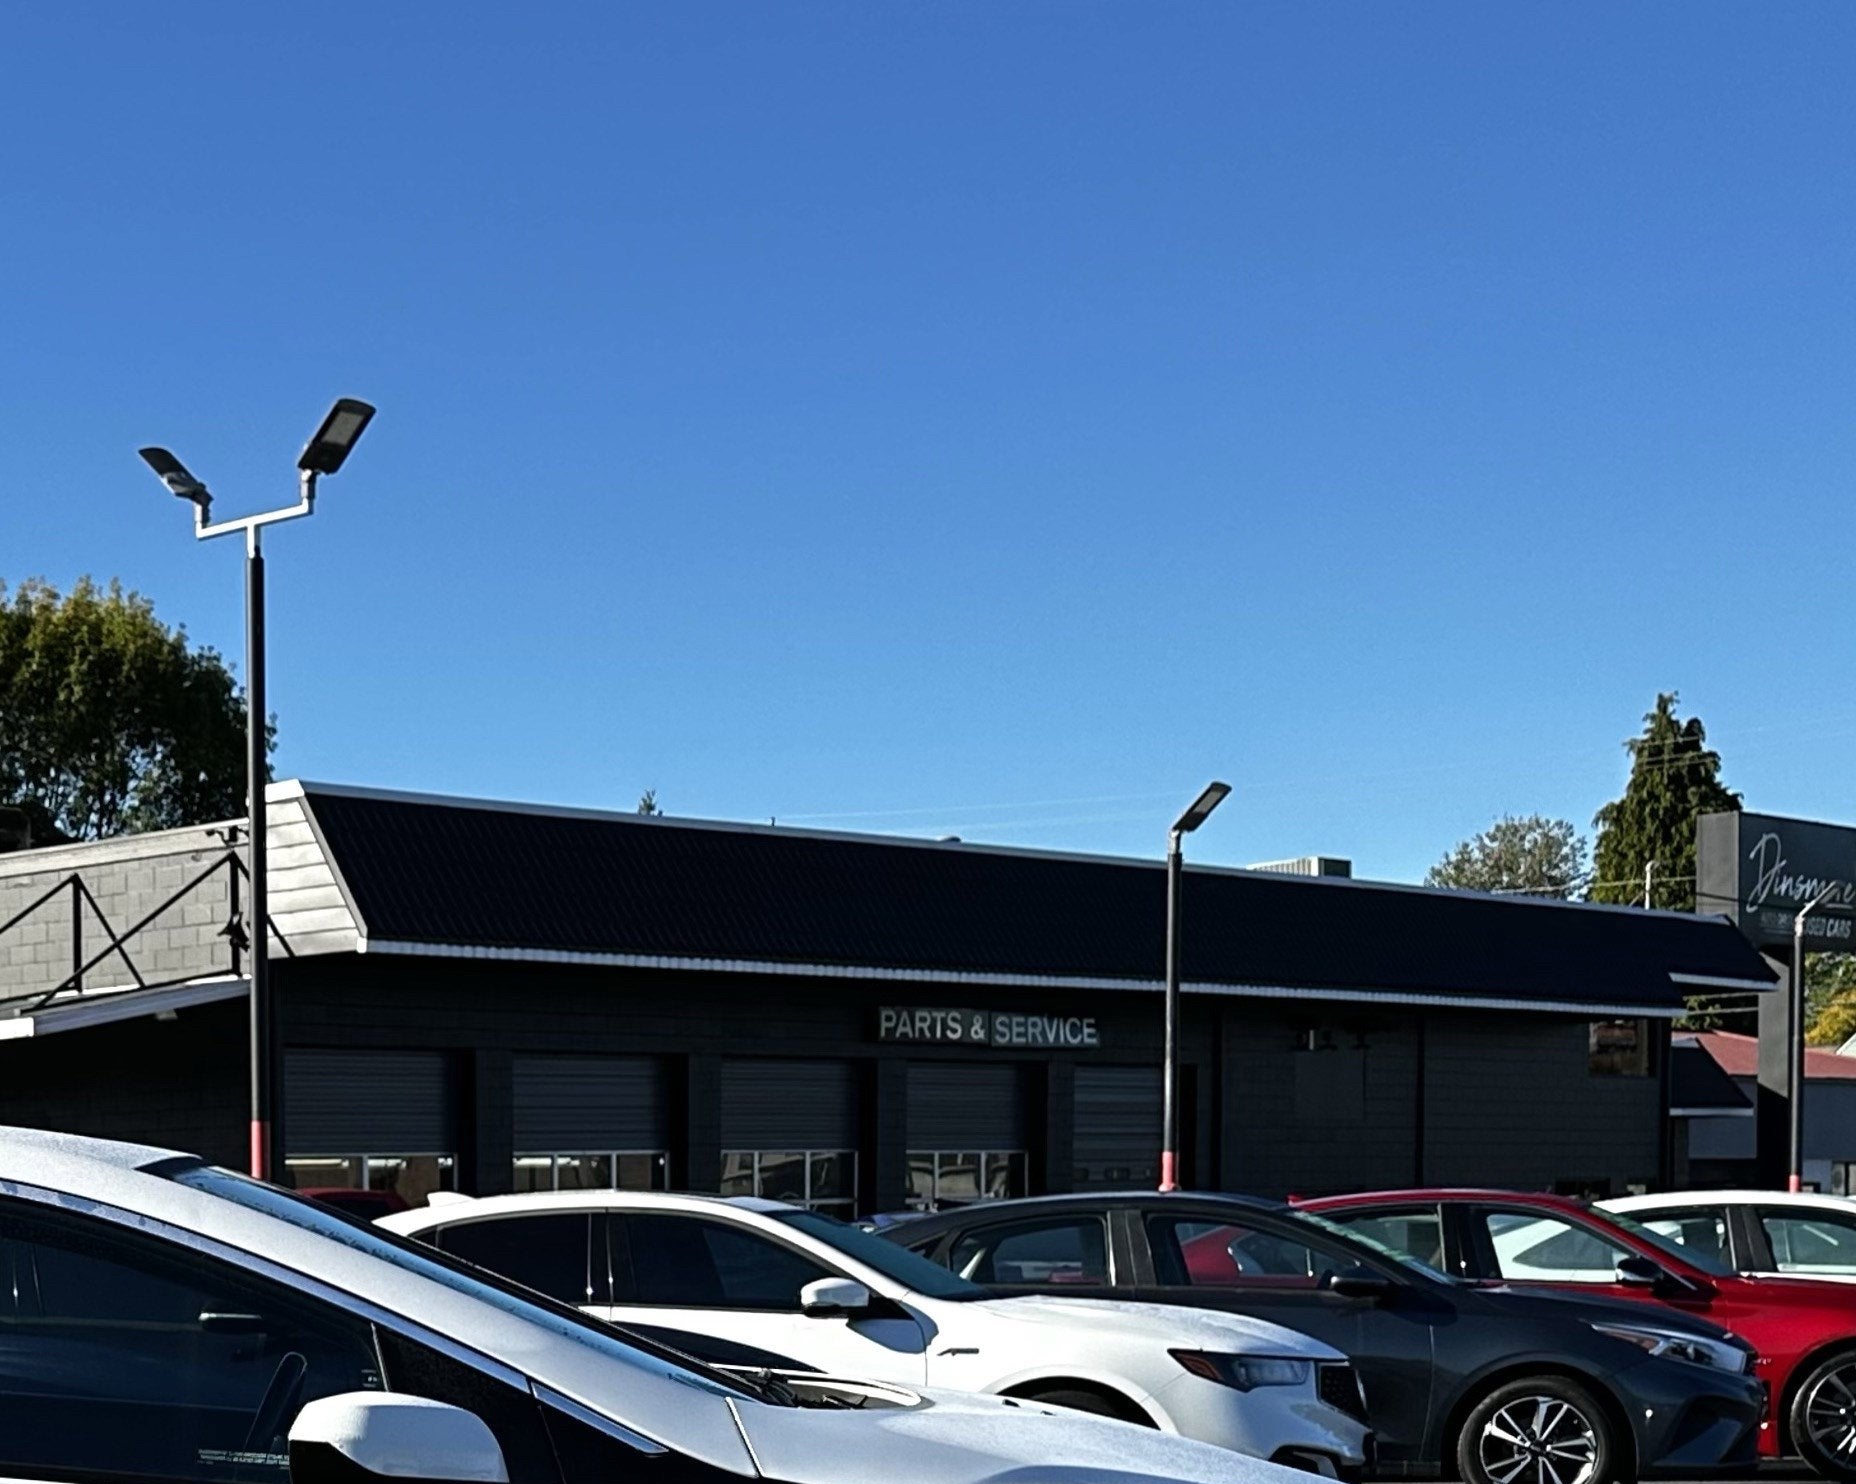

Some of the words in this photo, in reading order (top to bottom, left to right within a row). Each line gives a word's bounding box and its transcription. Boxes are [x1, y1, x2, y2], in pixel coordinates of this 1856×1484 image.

[879, 1010, 962, 1040] PARTS
[970, 1015, 986, 1040] &
[994, 1016, 1099, 1045] SERVICE
